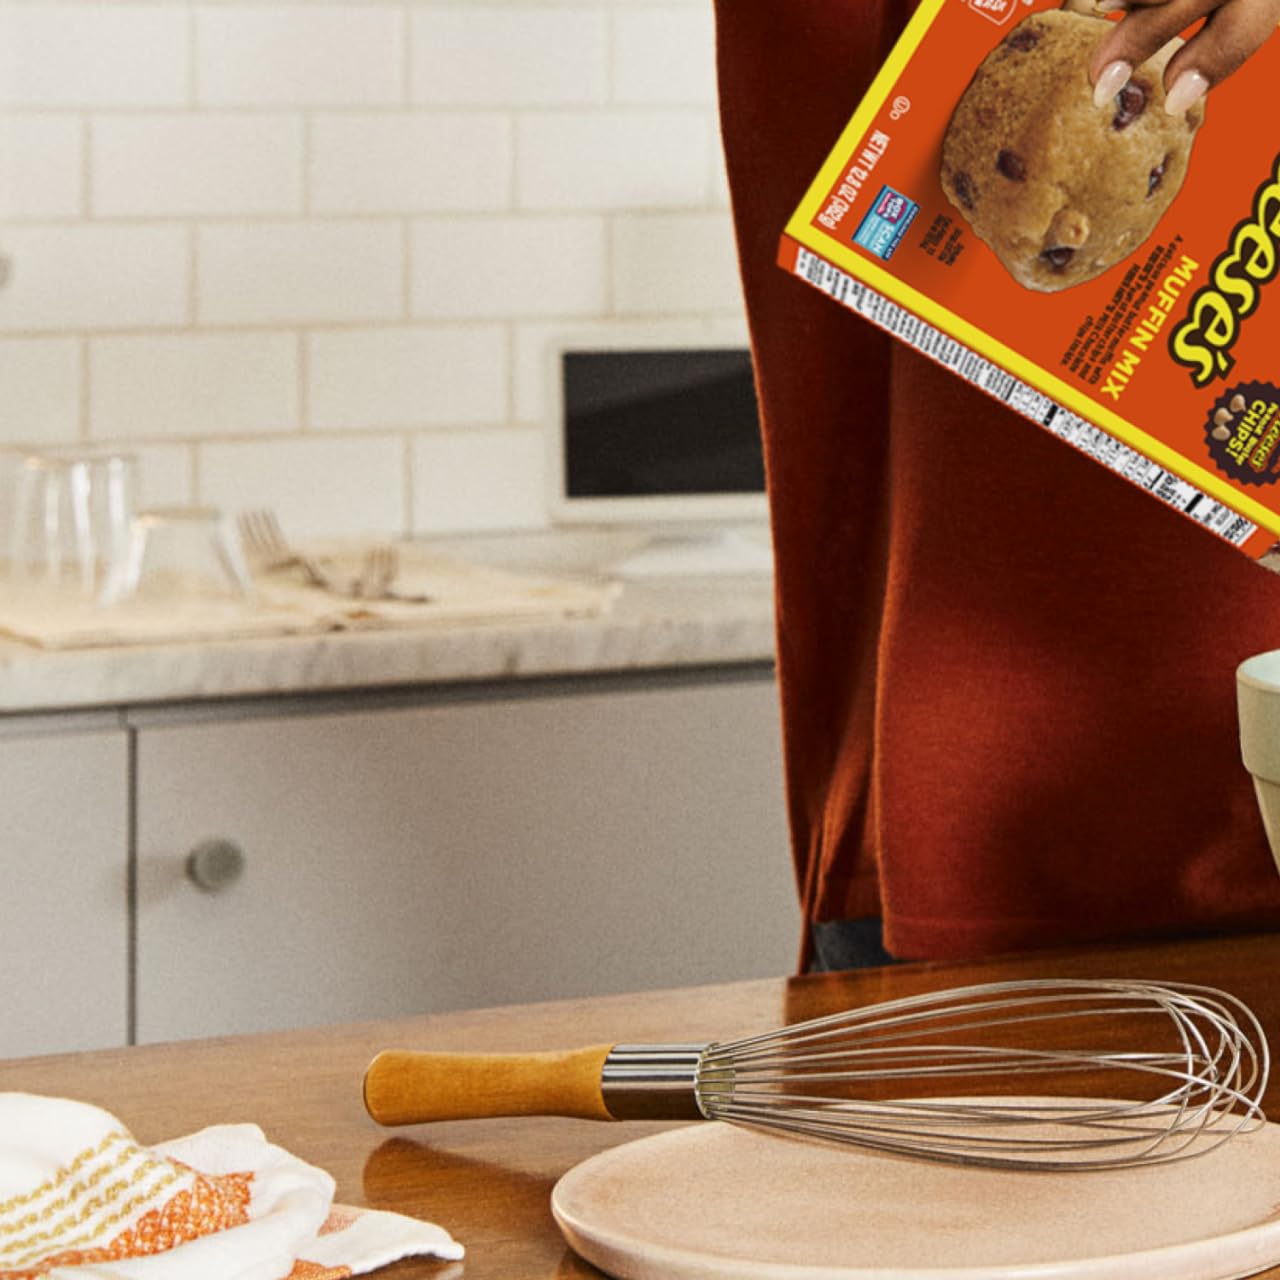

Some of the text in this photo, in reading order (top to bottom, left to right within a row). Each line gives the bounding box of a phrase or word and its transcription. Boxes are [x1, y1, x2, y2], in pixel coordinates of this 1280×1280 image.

[868, 129, 889, 155] NET
[858, 148, 880, 170] WT
[837, 183, 857, 202] OZ
[1100, 255, 1198, 400] MUFFIN MIX
[1225, 399, 1266, 458] CHIPS!
